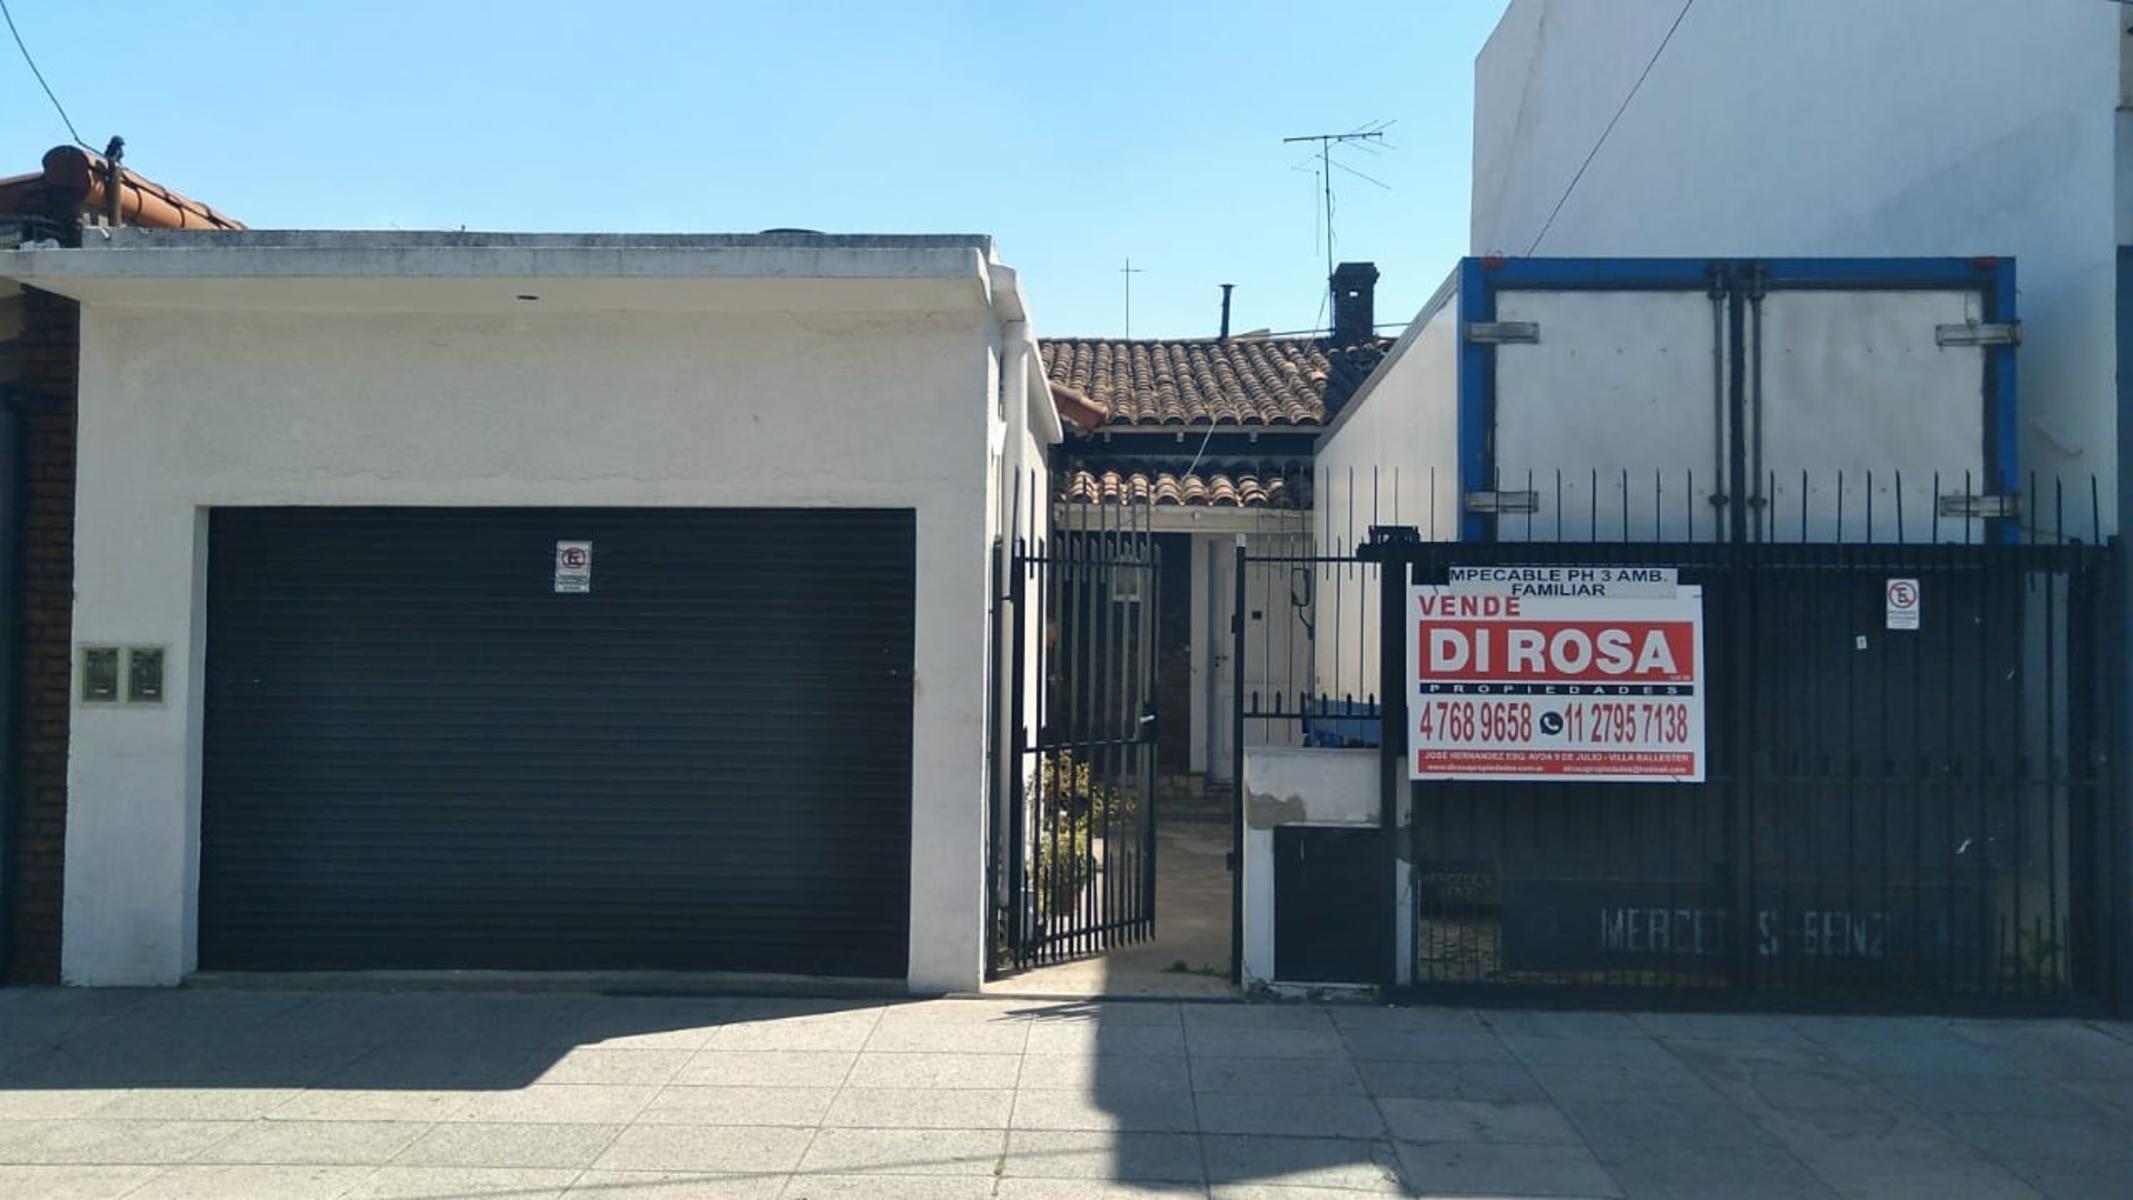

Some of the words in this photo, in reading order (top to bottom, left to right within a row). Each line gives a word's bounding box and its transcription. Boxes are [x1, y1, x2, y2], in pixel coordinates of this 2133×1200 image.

[1450, 569, 1562, 582] MPECABLE
[1568, 570, 1595, 582] PH
[1601, 570, 1612, 582] 3
[1616, 570, 1668, 582] AMB.
[1511, 584, 1606, 597] FAMILIAR
[1417, 595, 1520, 616] VENDE
[1429, 628, 1490, 672] DI
[1507, 628, 1678, 674] ROSA
[1429, 684, 1679, 695] PROPIEDADES
[1480, 702, 1533, 743] 9658
[1564, 702, 1584, 743] 11
[1590, 703, 1636, 743] 2795
[1642, 703, 1689, 744] 7138
[1608, 753, 1635, 761] VILLA
